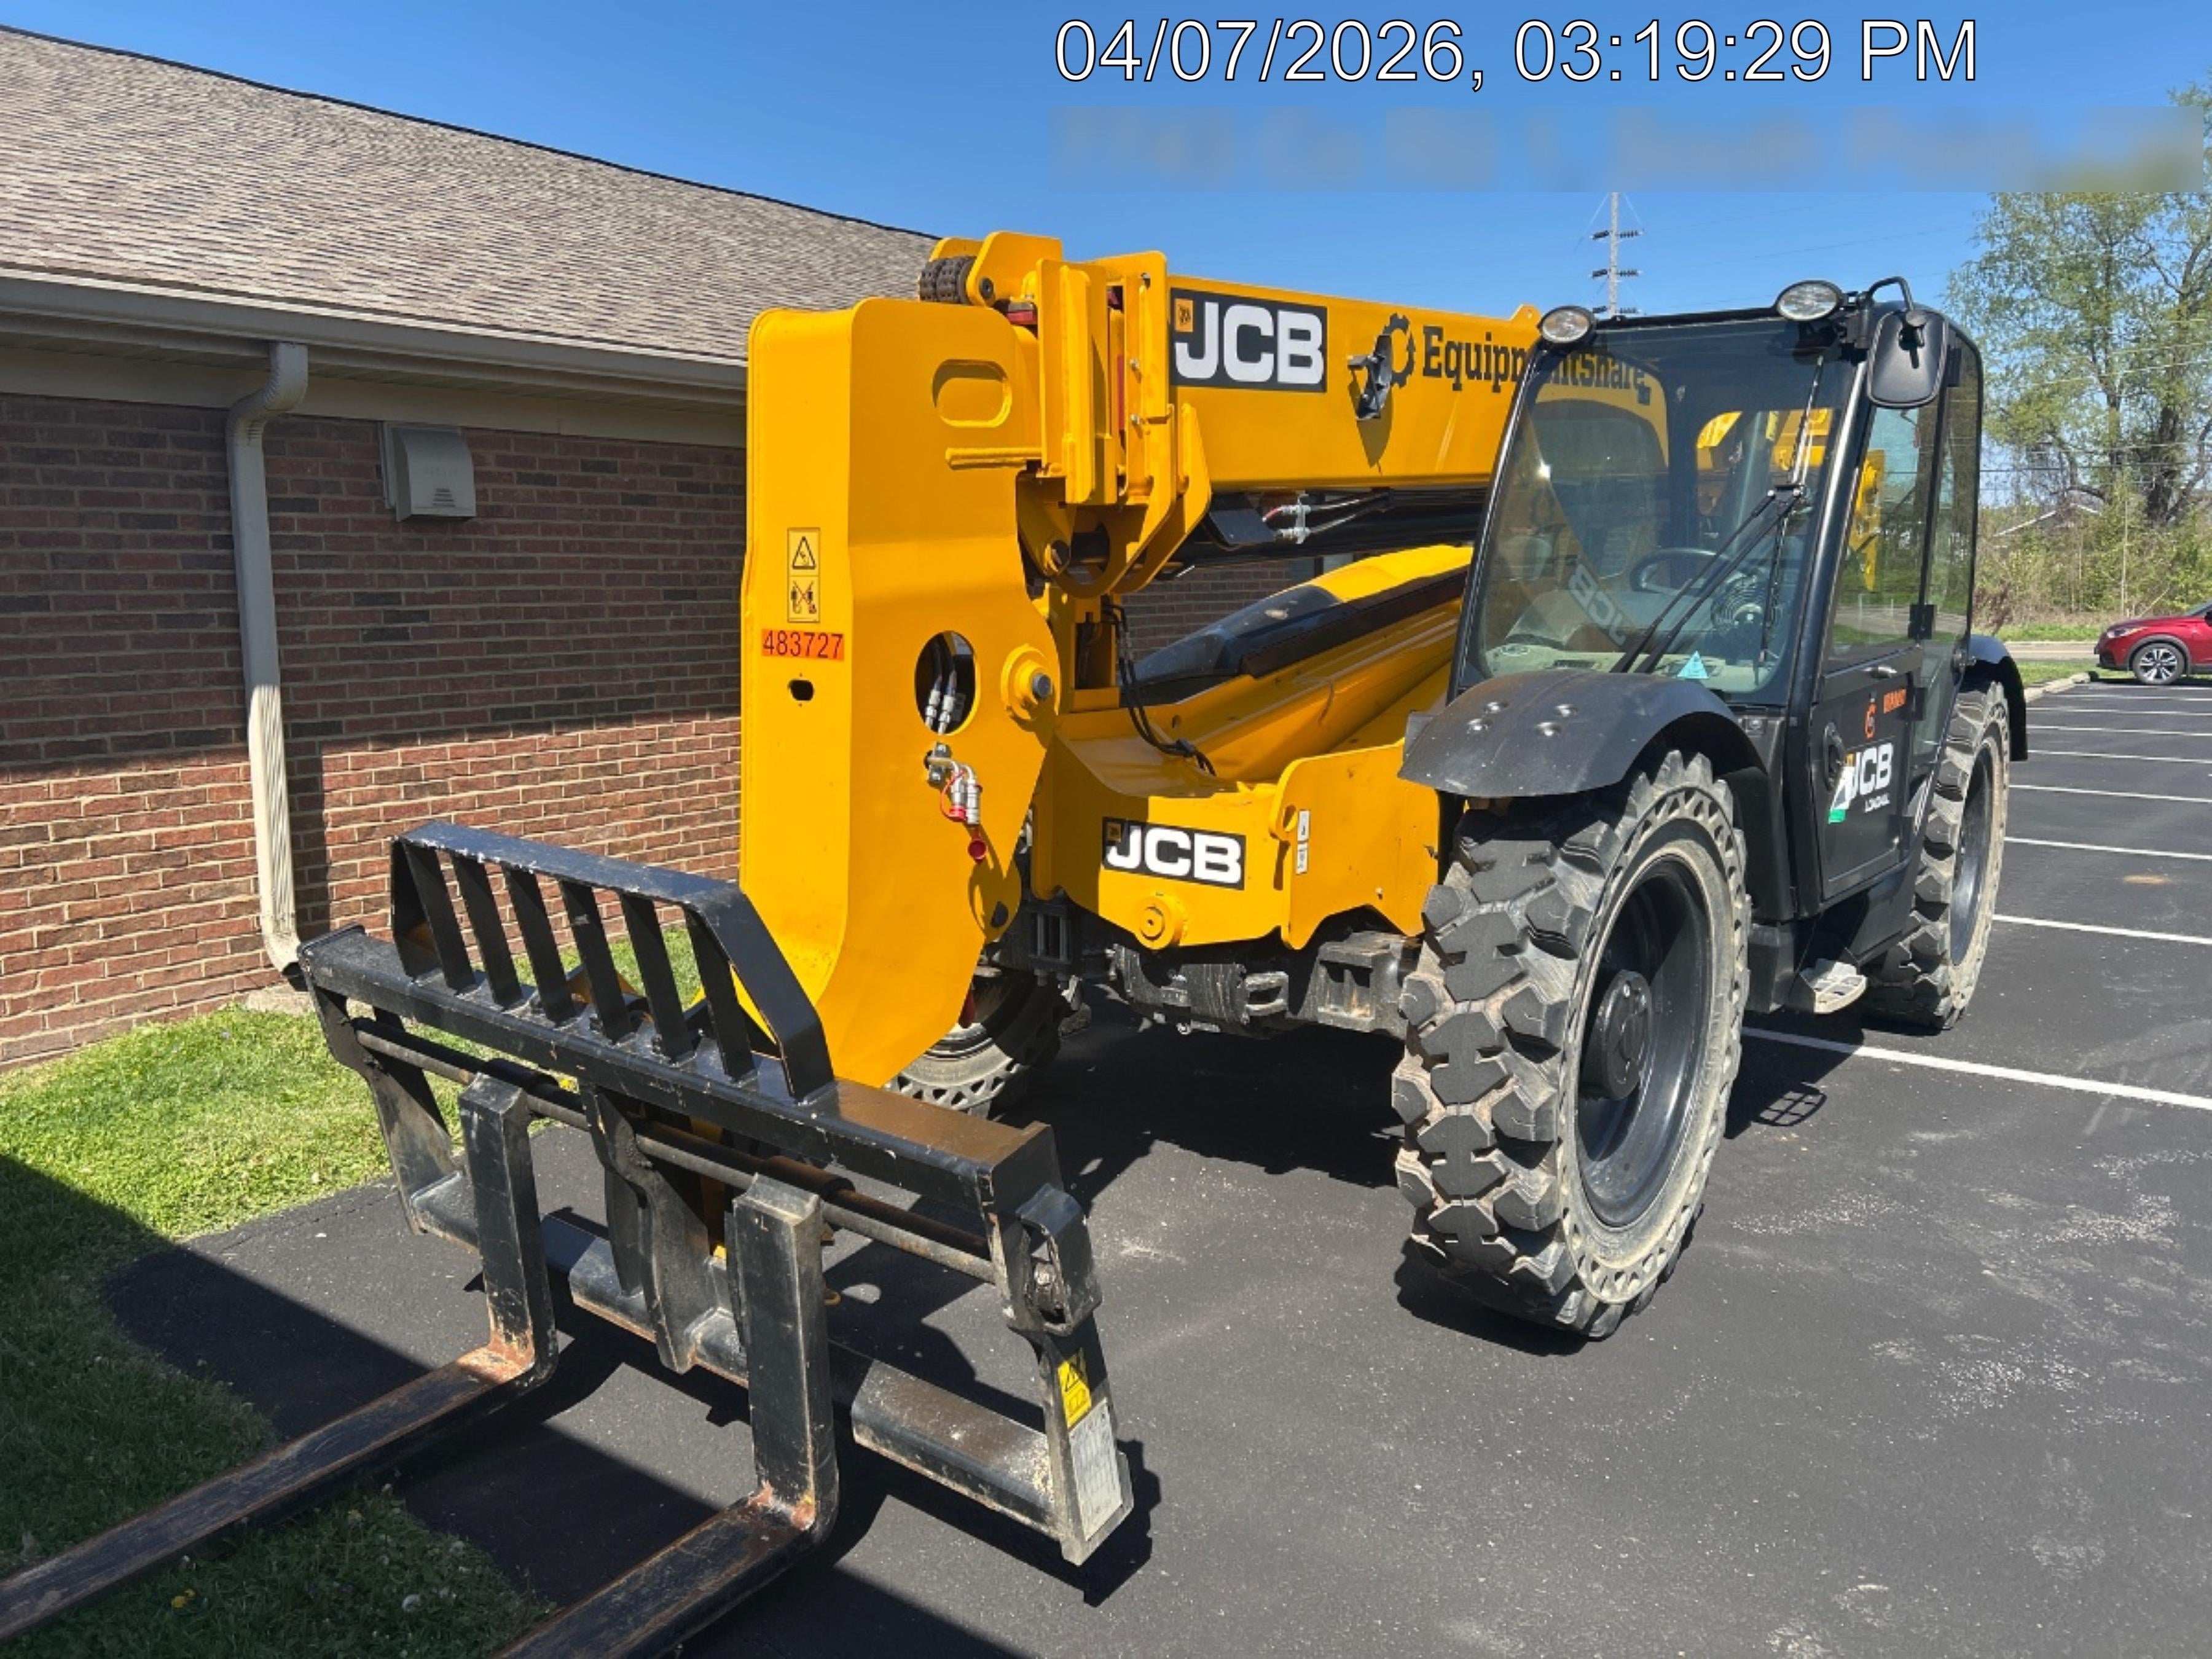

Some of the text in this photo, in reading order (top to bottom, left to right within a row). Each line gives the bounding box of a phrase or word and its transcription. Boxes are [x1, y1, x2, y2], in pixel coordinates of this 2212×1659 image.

[1175, 302, 1324, 384] JCB
[763, 630, 843, 659] 483727
[1107, 825, 1242, 884] JCB
